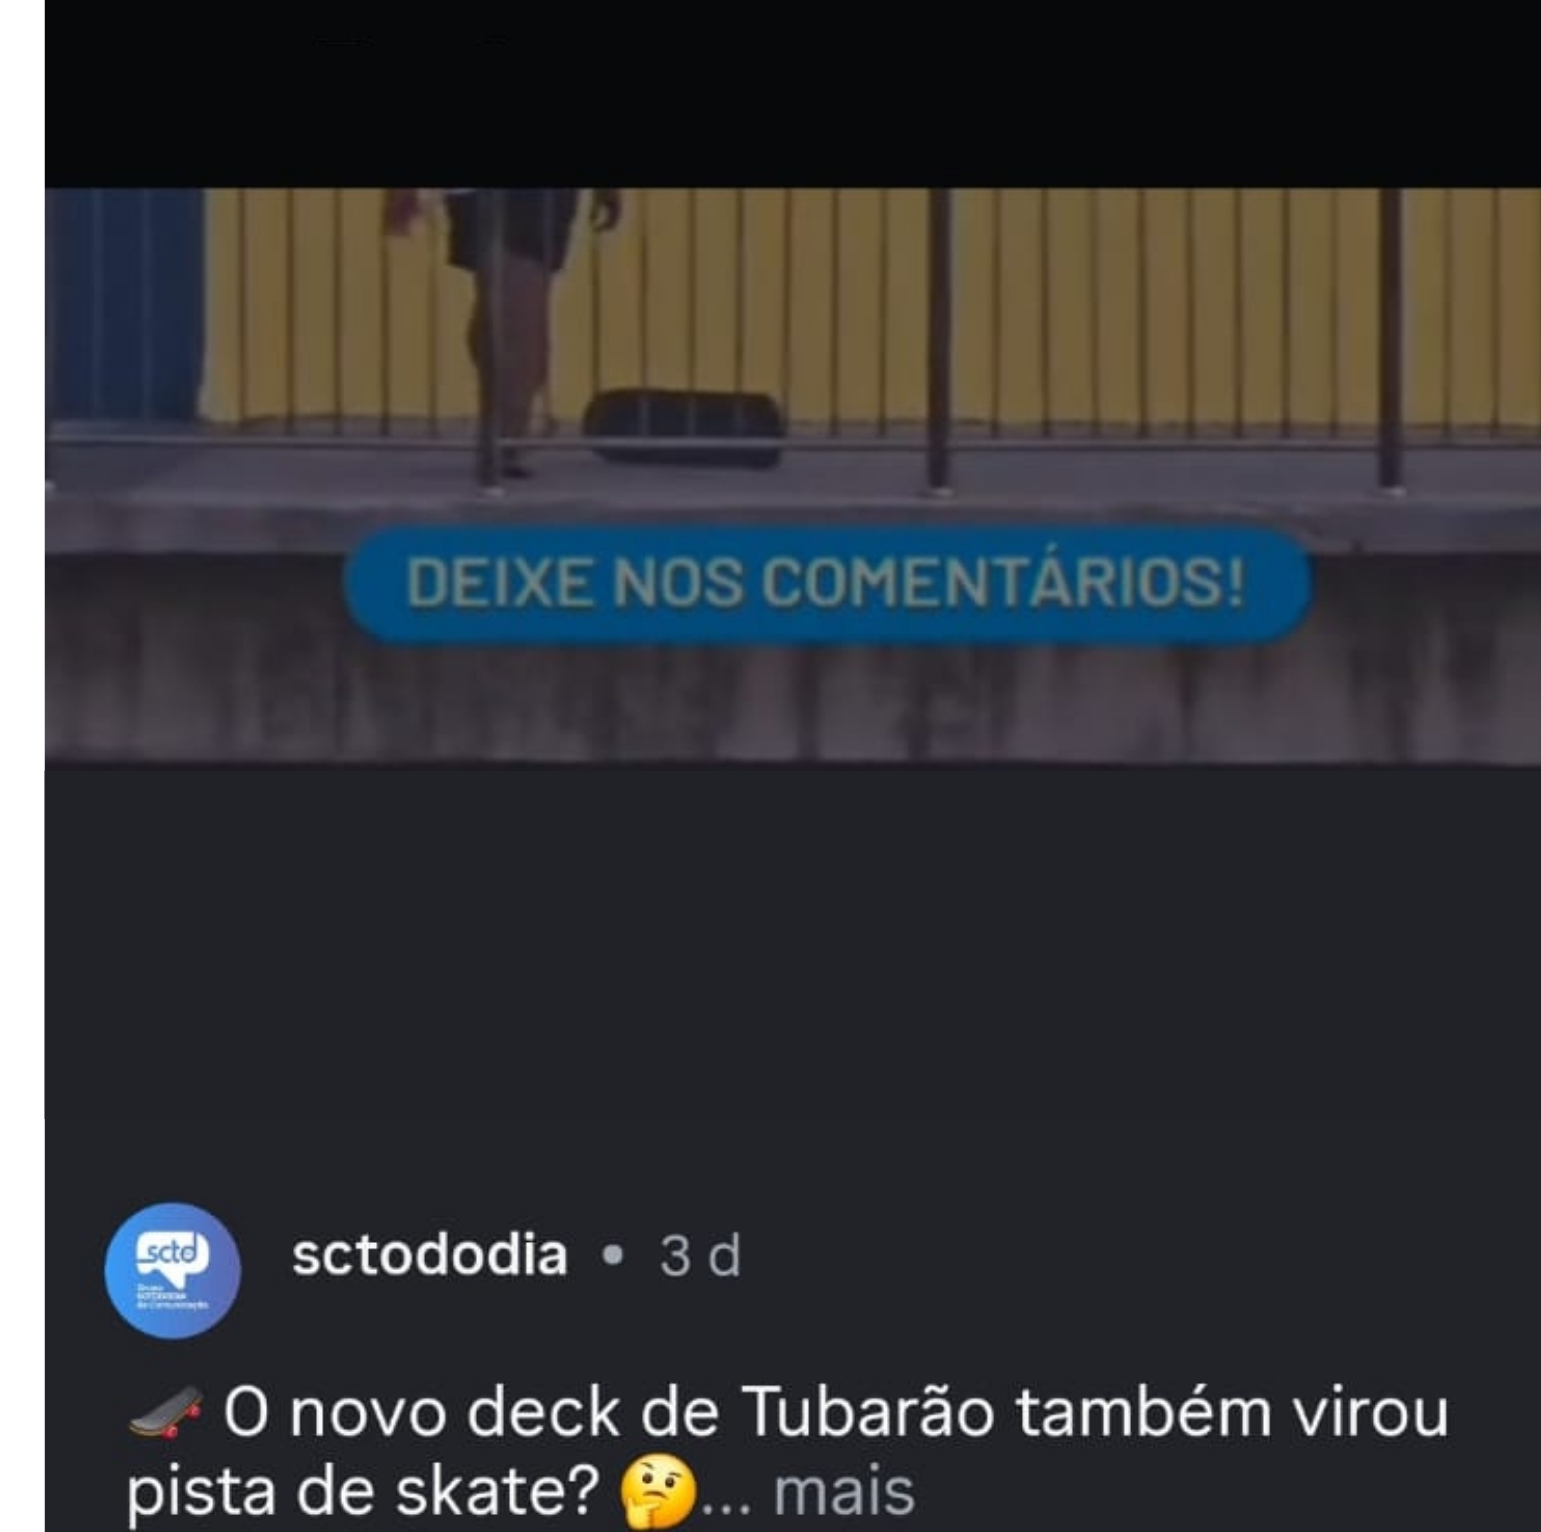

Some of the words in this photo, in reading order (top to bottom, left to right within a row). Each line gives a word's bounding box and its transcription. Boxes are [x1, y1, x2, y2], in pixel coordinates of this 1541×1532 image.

[292, 1230, 568, 1276] sctododia
[661, 1233, 691, 1277] 3
[709, 1231, 740, 1277] d
[224, 1384, 268, 1438] O
[292, 1397, 447, 1438] novo
[467, 1382, 621, 1438] deck
[641, 1382, 720, 1438] de
[740, 1382, 995, 1438] Tubarão
[1014, 1382, 1271, 1438] também
[1291, 1382, 1448, 1438] virou
[128, 1461, 276, 1532] pista
[297, 1461, 375, 1516] de
[396, 1461, 600, 1516] skate?
[775, 1461, 916, 1516] mais
